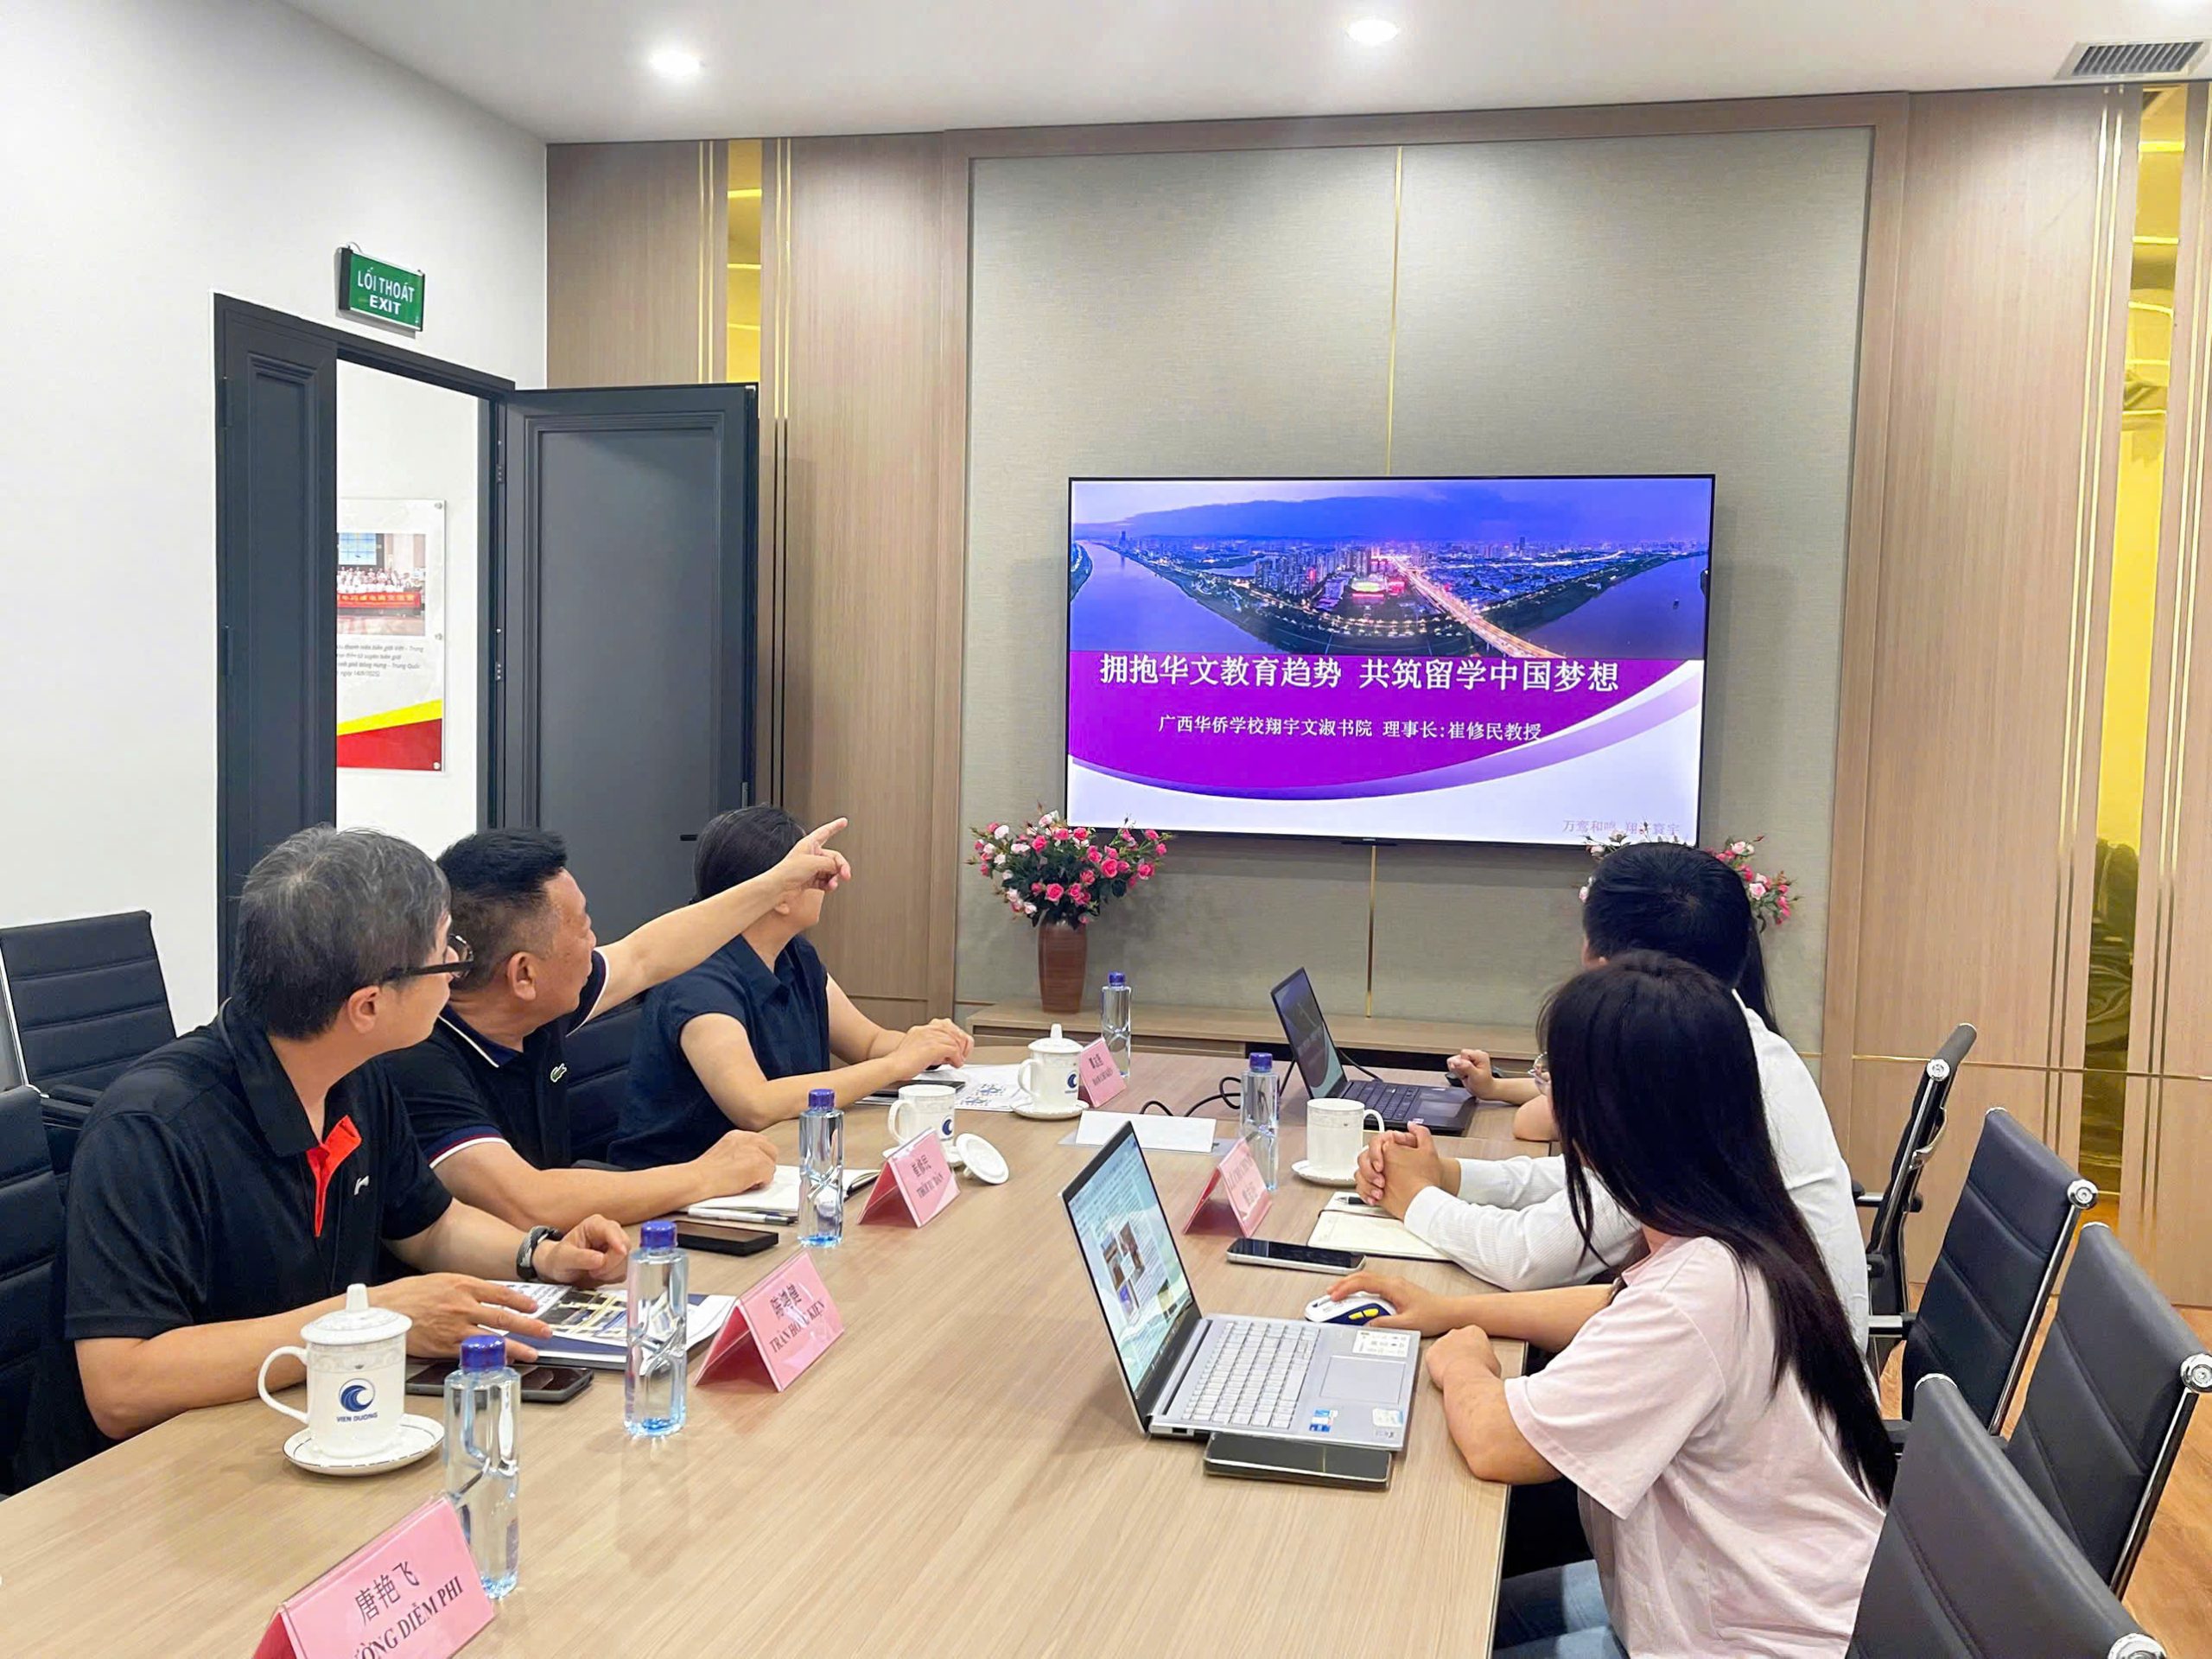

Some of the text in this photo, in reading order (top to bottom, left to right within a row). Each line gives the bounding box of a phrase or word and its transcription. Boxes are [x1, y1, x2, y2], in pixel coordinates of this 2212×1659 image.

[357, 267, 415, 302] LỐI THOÁT
[370, 295, 401, 315] EXIT
[1099, 653, 1619, 692] 拥抱华文教育趋势 共筑留学中国梦想
[1158, 715, 1373, 736] 广西华侨学校翔宇文淑书院
[355, 1560, 420, 1626] 唐艳飞
[436, 1575, 463, 1607] PHI
